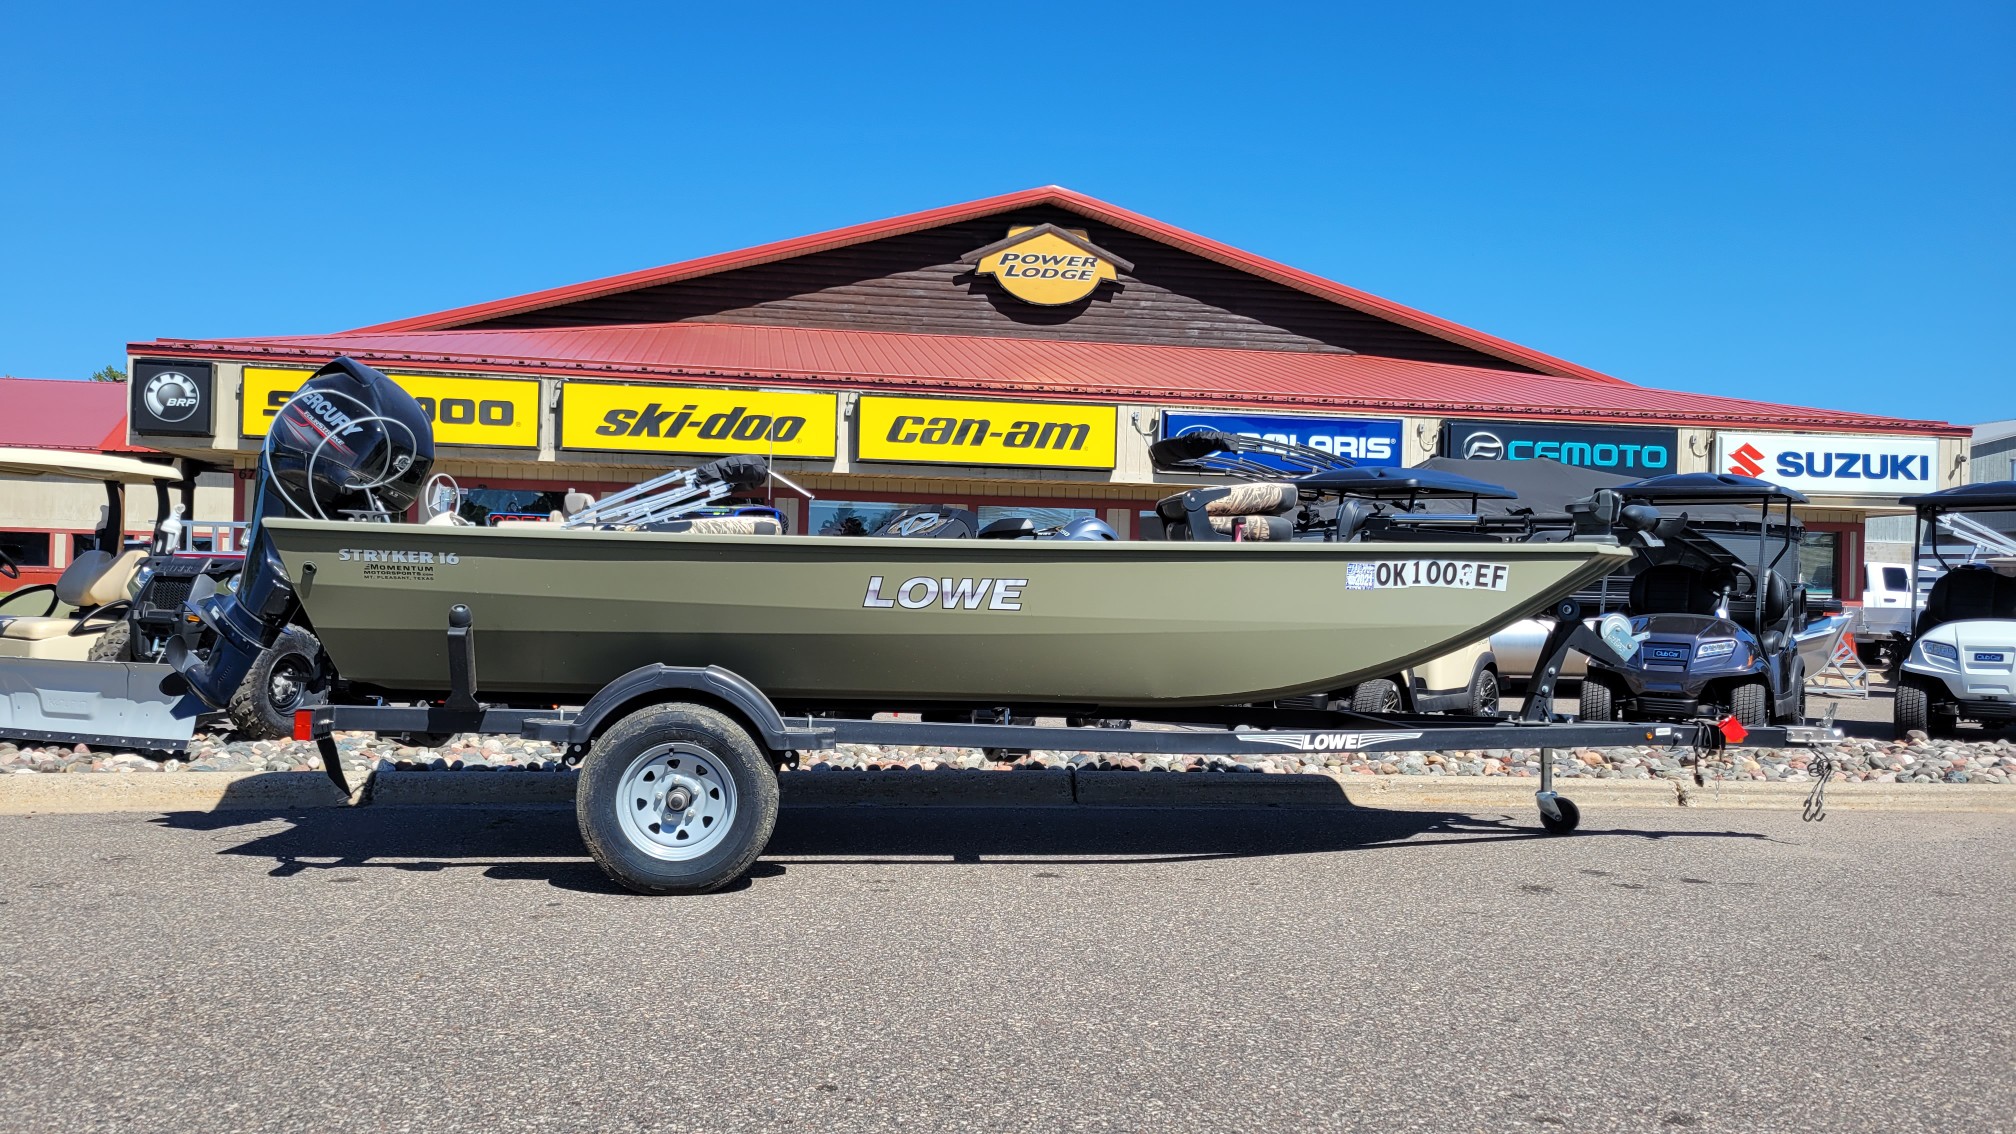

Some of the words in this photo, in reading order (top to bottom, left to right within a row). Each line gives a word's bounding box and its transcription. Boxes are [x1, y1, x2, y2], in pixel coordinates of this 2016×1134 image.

[999, 253, 1099, 269] POWER
[1004, 264, 1095, 281] LODGE
[166, 398, 197, 407] BRP
[595, 403, 807, 442] ski-doo
[886, 415, 1091, 450] can-am
[1776, 451, 1929, 480] SUZUKI
[338, 548, 435, 564] STRYKER
[438, 552, 460, 565] 16
[862, 575, 1029, 611] LOWE
[1303, 734, 1359, 750] LOWE
